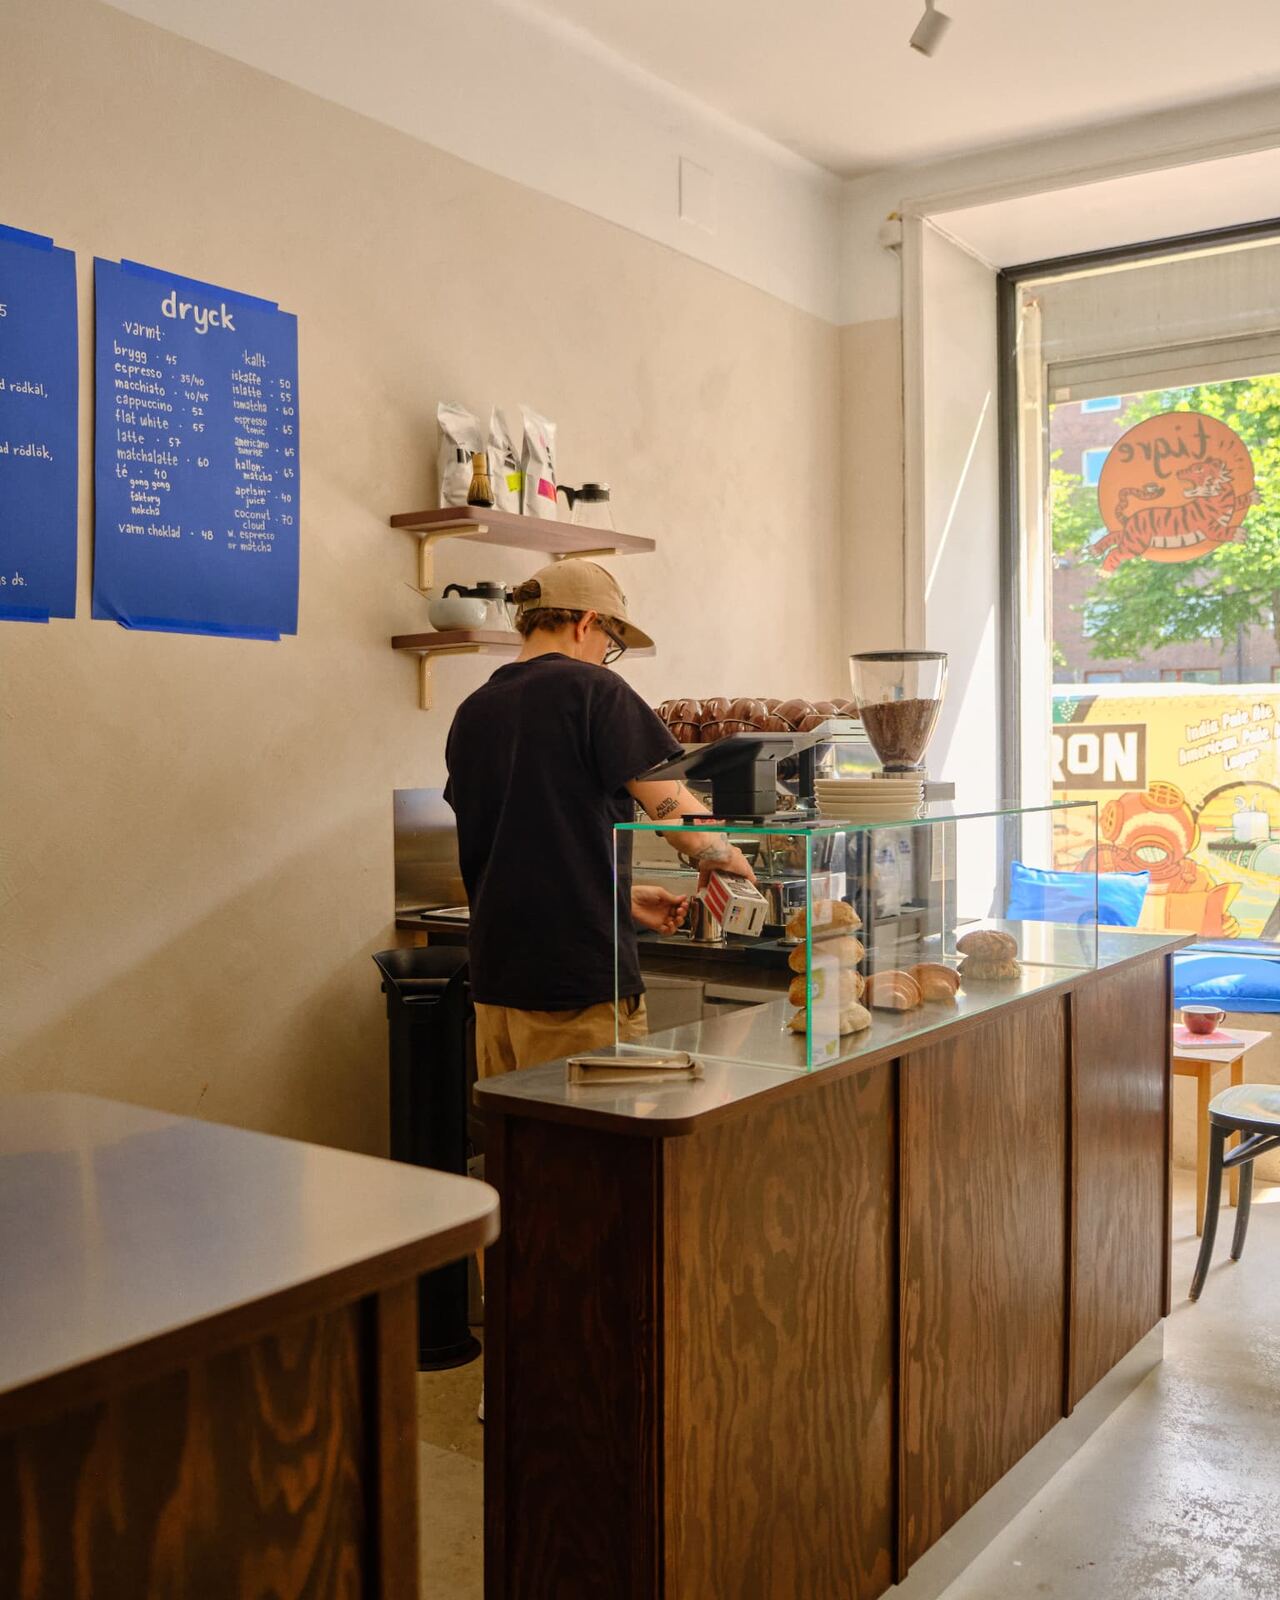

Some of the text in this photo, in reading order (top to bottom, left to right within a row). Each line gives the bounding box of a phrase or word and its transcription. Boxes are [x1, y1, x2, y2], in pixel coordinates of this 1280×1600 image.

[162, 291, 236, 334] dryck
[114, 340, 176, 364] brygg 45
[115, 363, 204, 386] espresso 35/40
[232, 370, 290, 389] iskaffe 50
[115, 380, 208, 402] macchiato 40/45
[233, 384, 291, 402] islatte 55
[116, 392, 203, 416] cappuccino 52
[234, 400, 294, 415] ismatcha 60
[116, 408, 204, 432] flat white 55
[234, 417, 267, 428] espresso
[246, 424, 292, 435] tonic 65
[118, 429, 181, 447] latte 57
[235, 437, 269, 450] americano
[14, 442, 53, 462] rödlök,
[117, 447, 209, 467] matchalatte 60
[285, 448, 294, 456] 65
[116, 464, 167, 479] té 40
[235, 458, 264, 472] hallon-
[243, 468, 293, 481] matcha 65
[130, 479, 170, 491] gong gong
[131, 491, 160, 506] faktory
[246, 493, 291, 508] juice 40
[132, 505, 160, 515] nokcha
[234, 509, 270, 522] coconut
[243, 515, 293, 530] cloud 70
[118, 522, 213, 541] varm choklad 48
[240, 531, 274, 543] espresso
[240, 540, 271, 552] matcha
[12, 572, 27, 585] ds.
